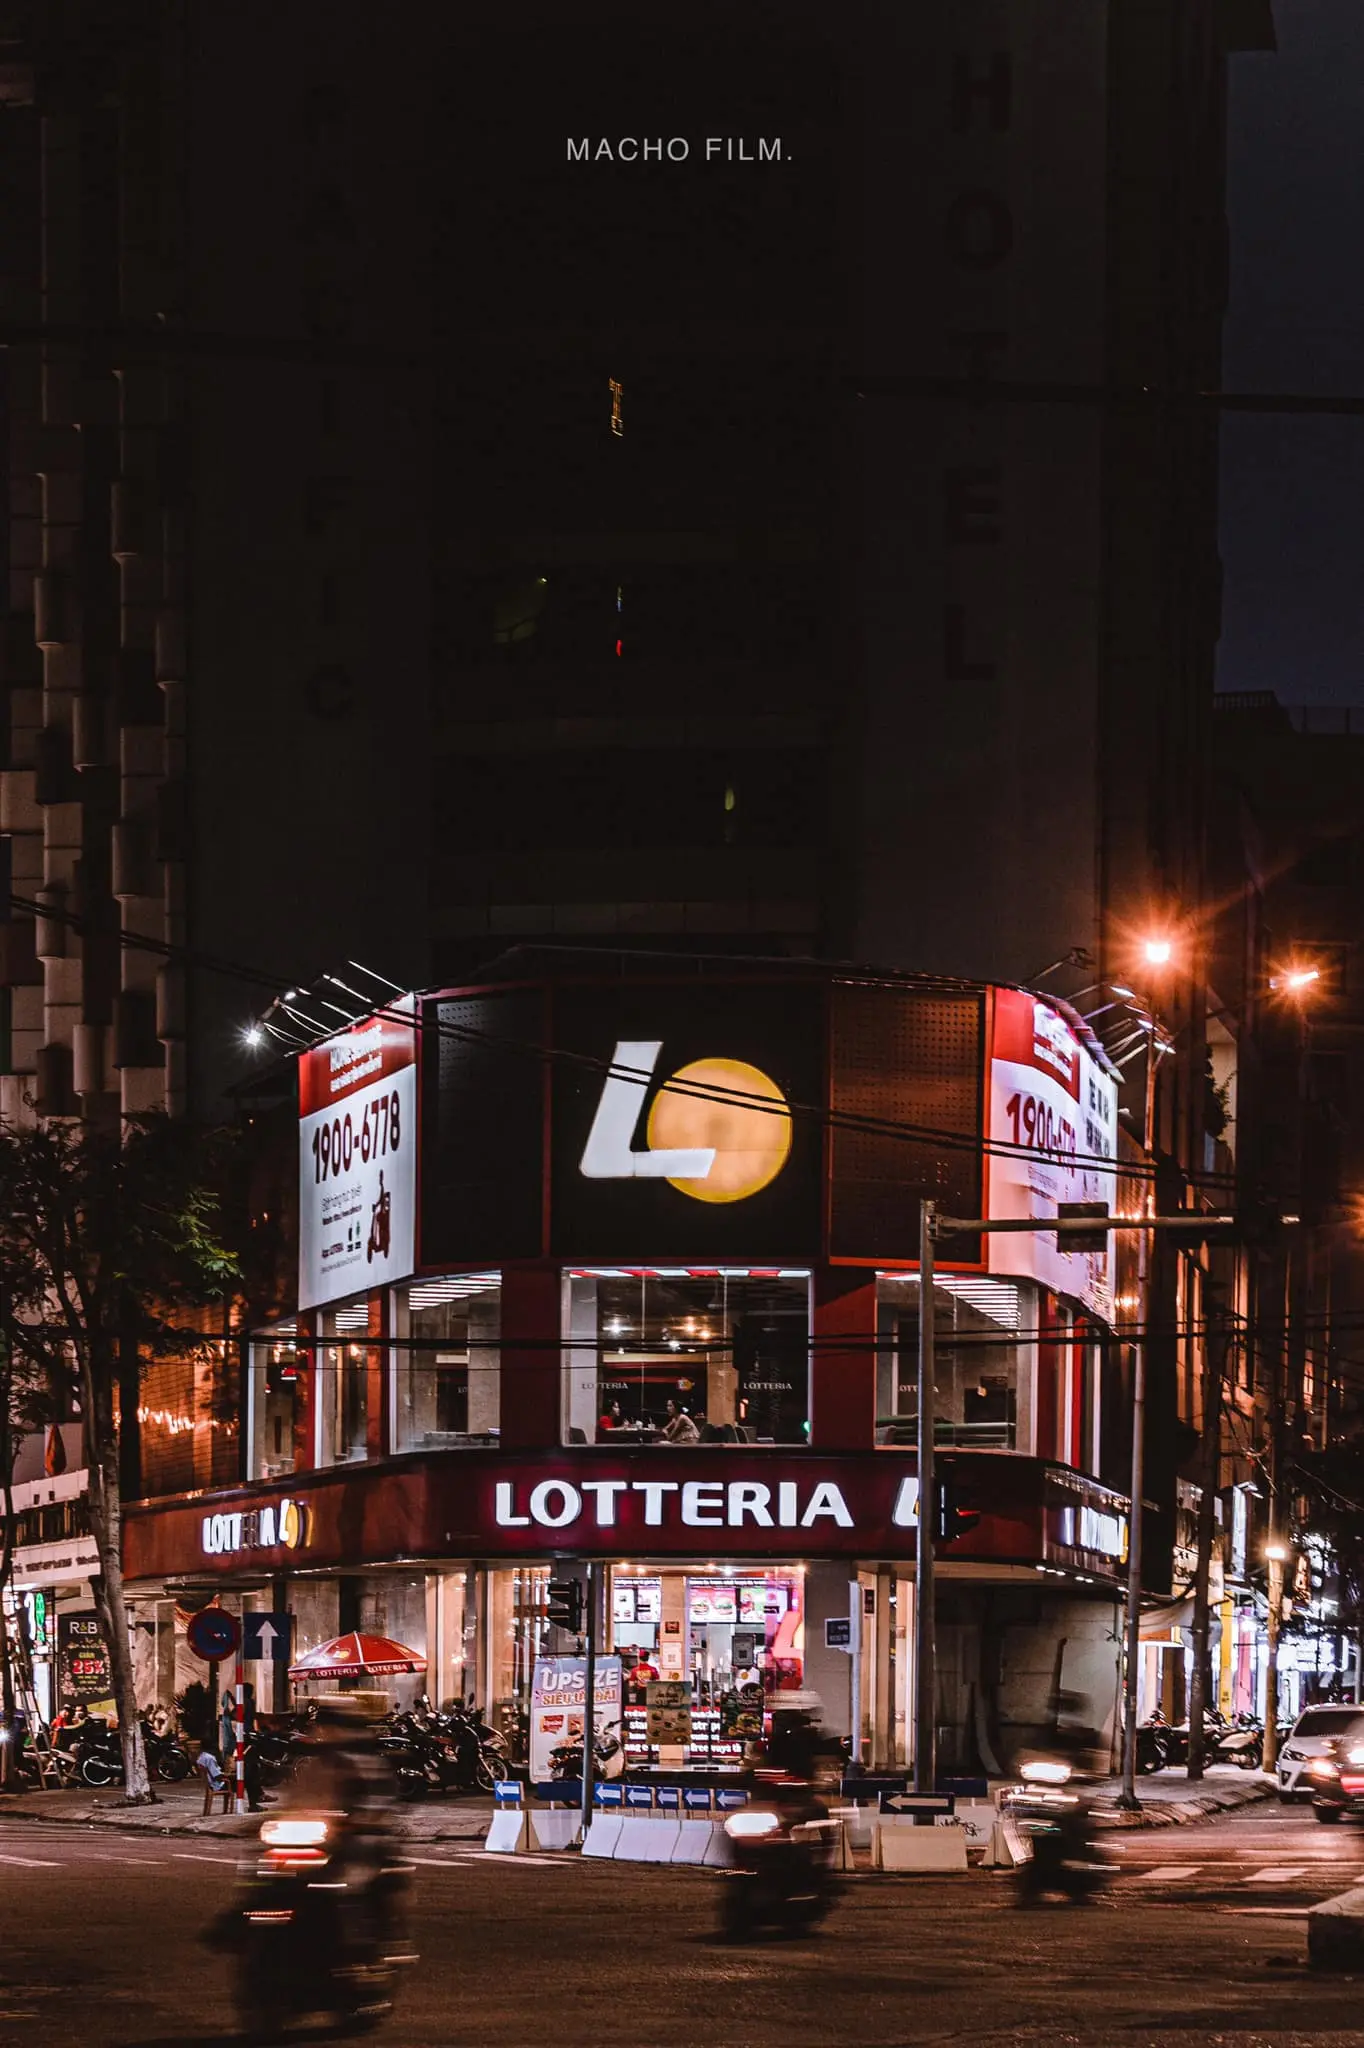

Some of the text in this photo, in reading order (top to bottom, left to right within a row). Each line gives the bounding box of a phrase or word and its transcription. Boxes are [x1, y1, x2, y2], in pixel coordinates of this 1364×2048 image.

[312, 1090, 401, 1185] 1900-6778
[743, 1381, 793, 1390] LOTTERIA
[495, 1480, 854, 1527] LOTTERIA
[69, 1621, 98, 1634] R&B
[72, 1660, 105, 1674] 25%
[315, 1667, 359, 1678] LOTTERIA
[367, 1663, 409, 1673] LOTTERIA
[540, 1667, 619, 1691] UPSZE
[542, 1690, 571, 1706] SIÊU
